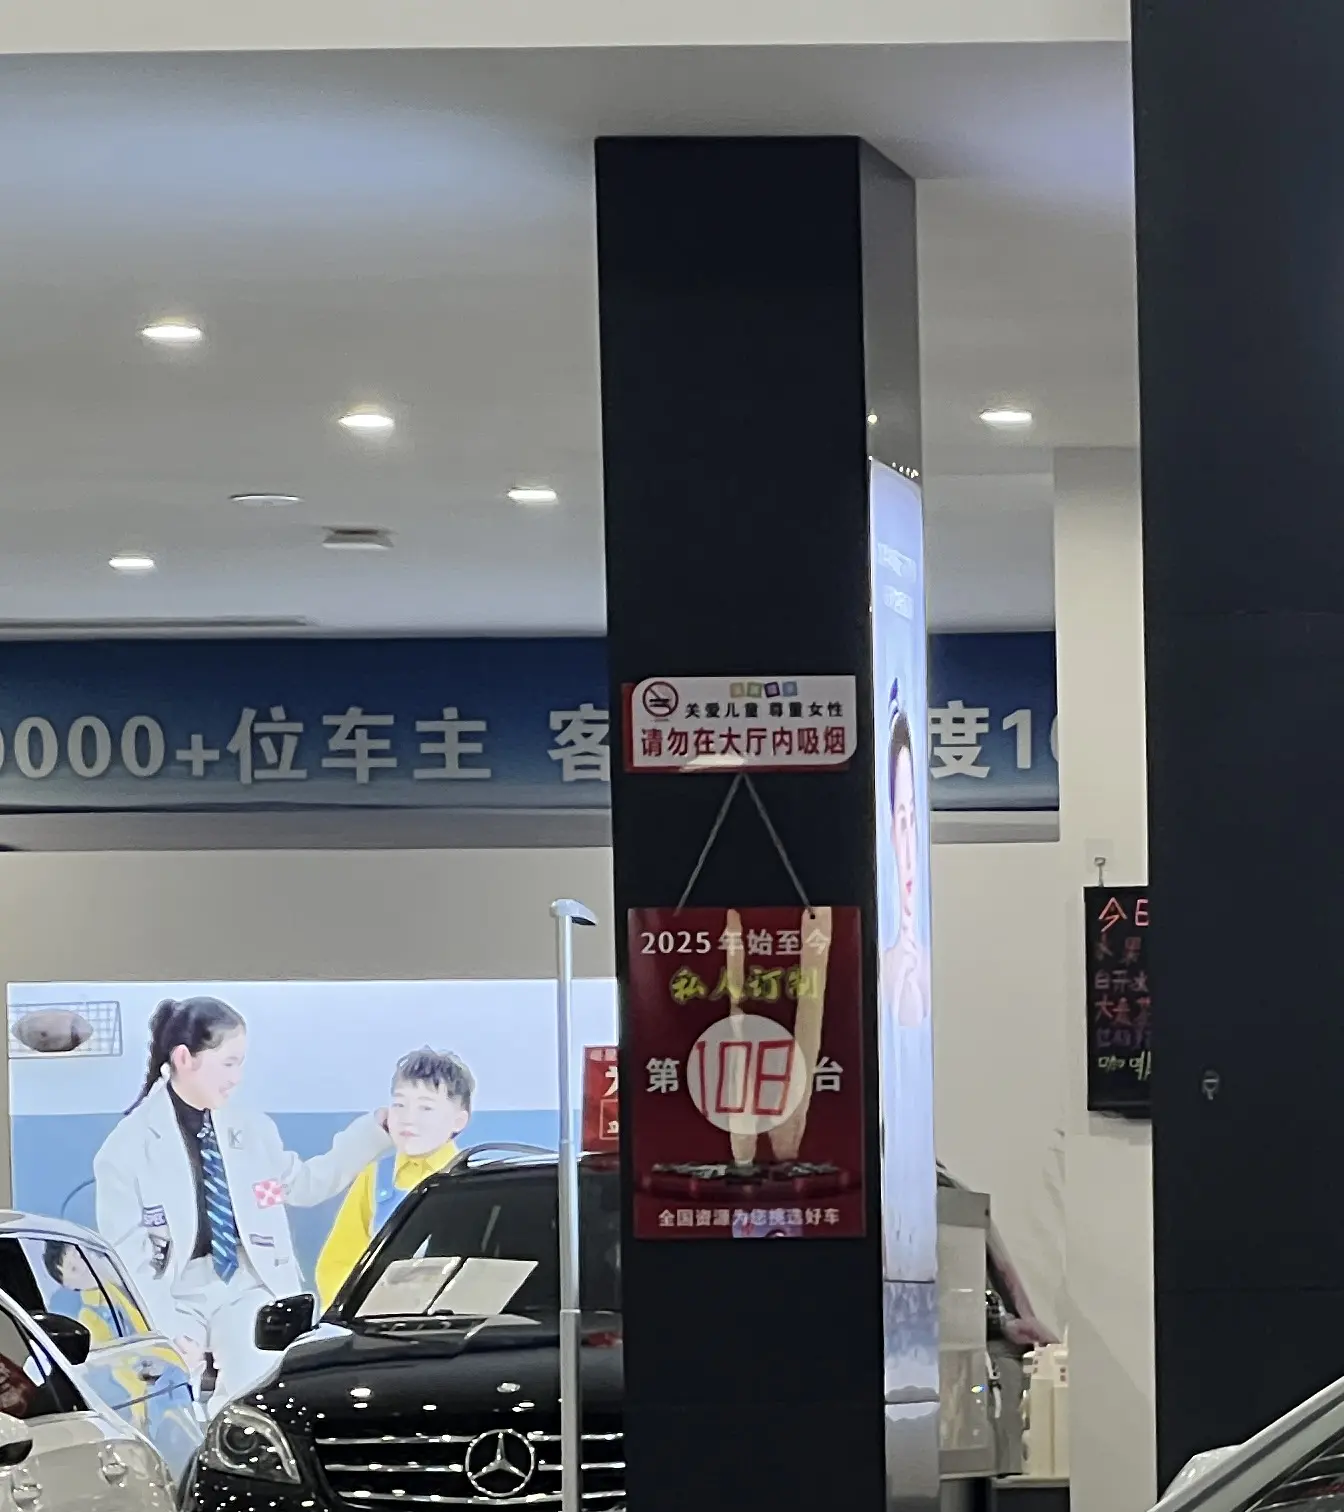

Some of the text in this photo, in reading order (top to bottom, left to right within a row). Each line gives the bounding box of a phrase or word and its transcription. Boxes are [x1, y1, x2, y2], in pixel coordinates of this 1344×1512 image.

[685, 701, 843, 719] 关爱儿童 尊重女性
[0, 704, 492, 785] 000+位车主
[641, 726, 846, 757] 请勿在大厅内吸烟
[640, 928, 829, 956] 2025 年始至今
[670, 966, 820, 1004] 私人订制
[645, 1057, 680, 1093] 第
[696, 1039, 797, 1118] 108
[812, 1056, 844, 1092] 台
